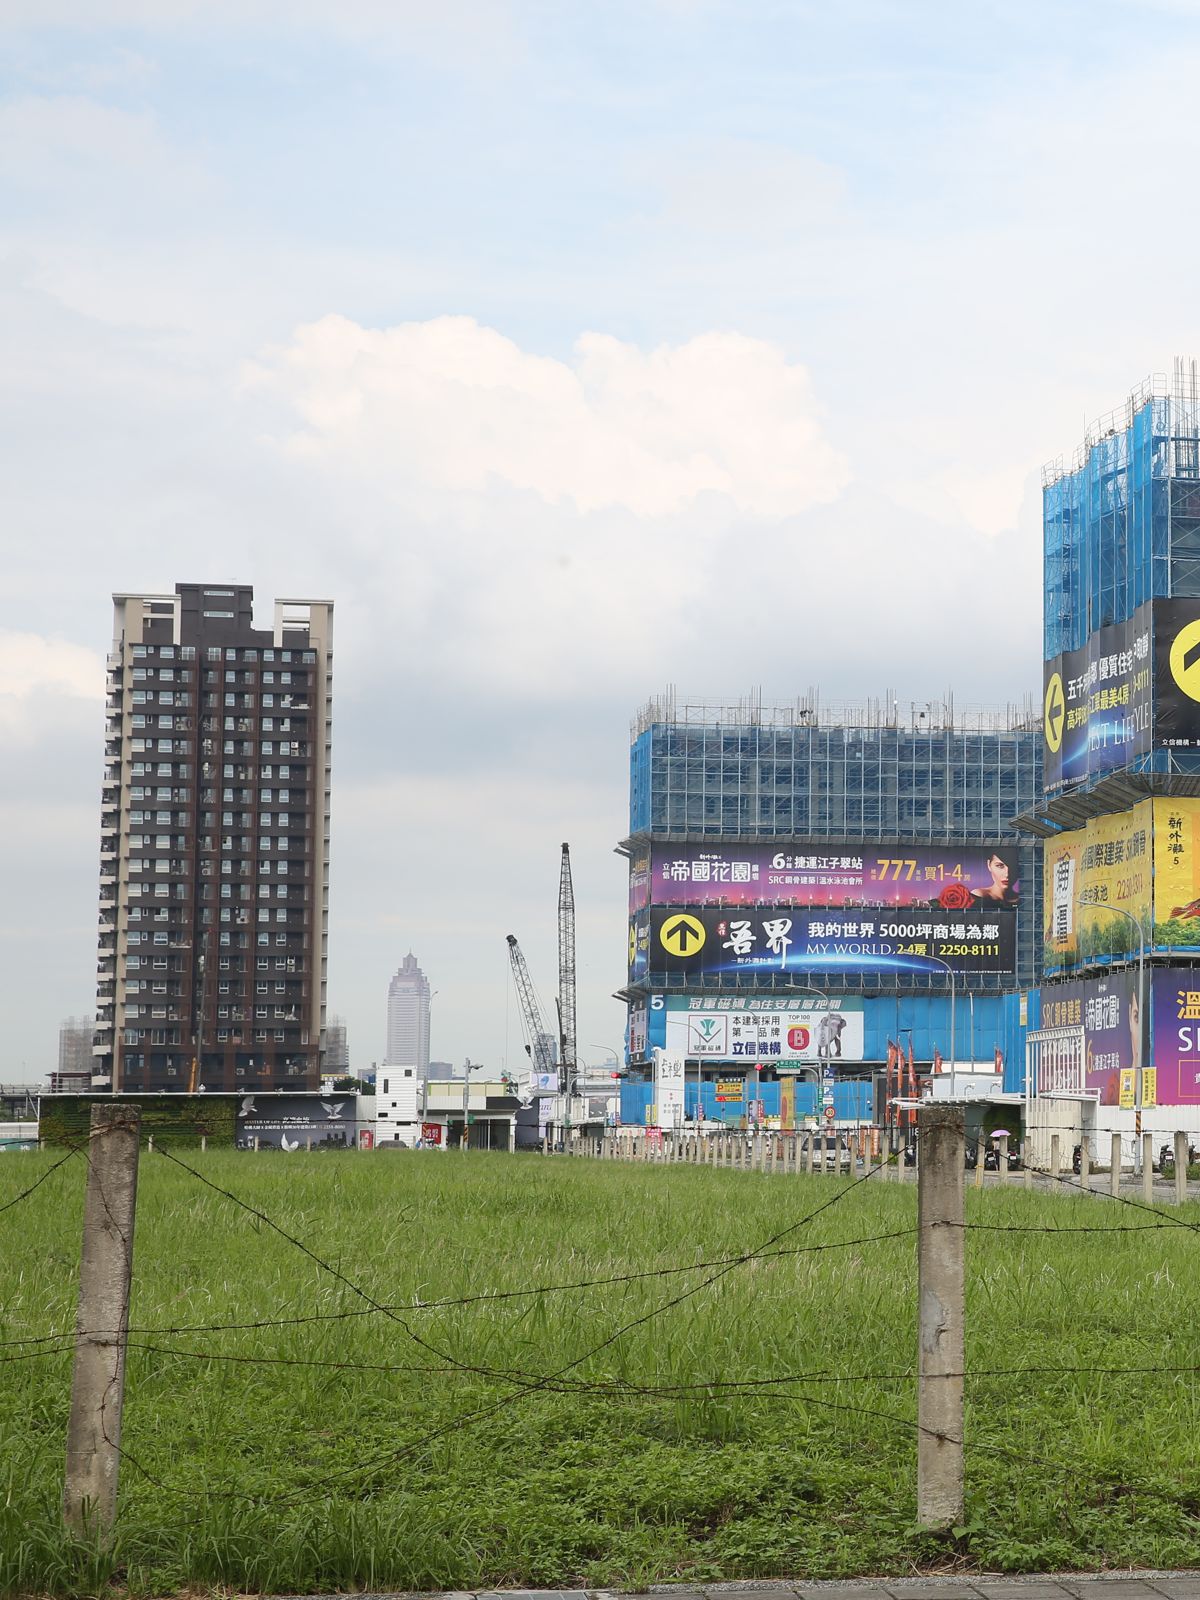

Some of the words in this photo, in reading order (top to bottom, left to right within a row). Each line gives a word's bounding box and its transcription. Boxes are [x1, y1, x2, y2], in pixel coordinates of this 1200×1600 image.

[794, 856, 863, 870] 捷運江子翠站
[877, 859, 917, 881] 777
[670, 860, 751, 882] 帝國花園
[808, 922, 875, 938] 我的世界
[879, 923, 1000, 940] 5000坪商場為鄰
[806, 944, 830, 955] MY
[939, 945, 999, 956] 2250-8111
[651, 995, 664, 1010] 5
[732, 1041, 781, 1056] 立信機構
